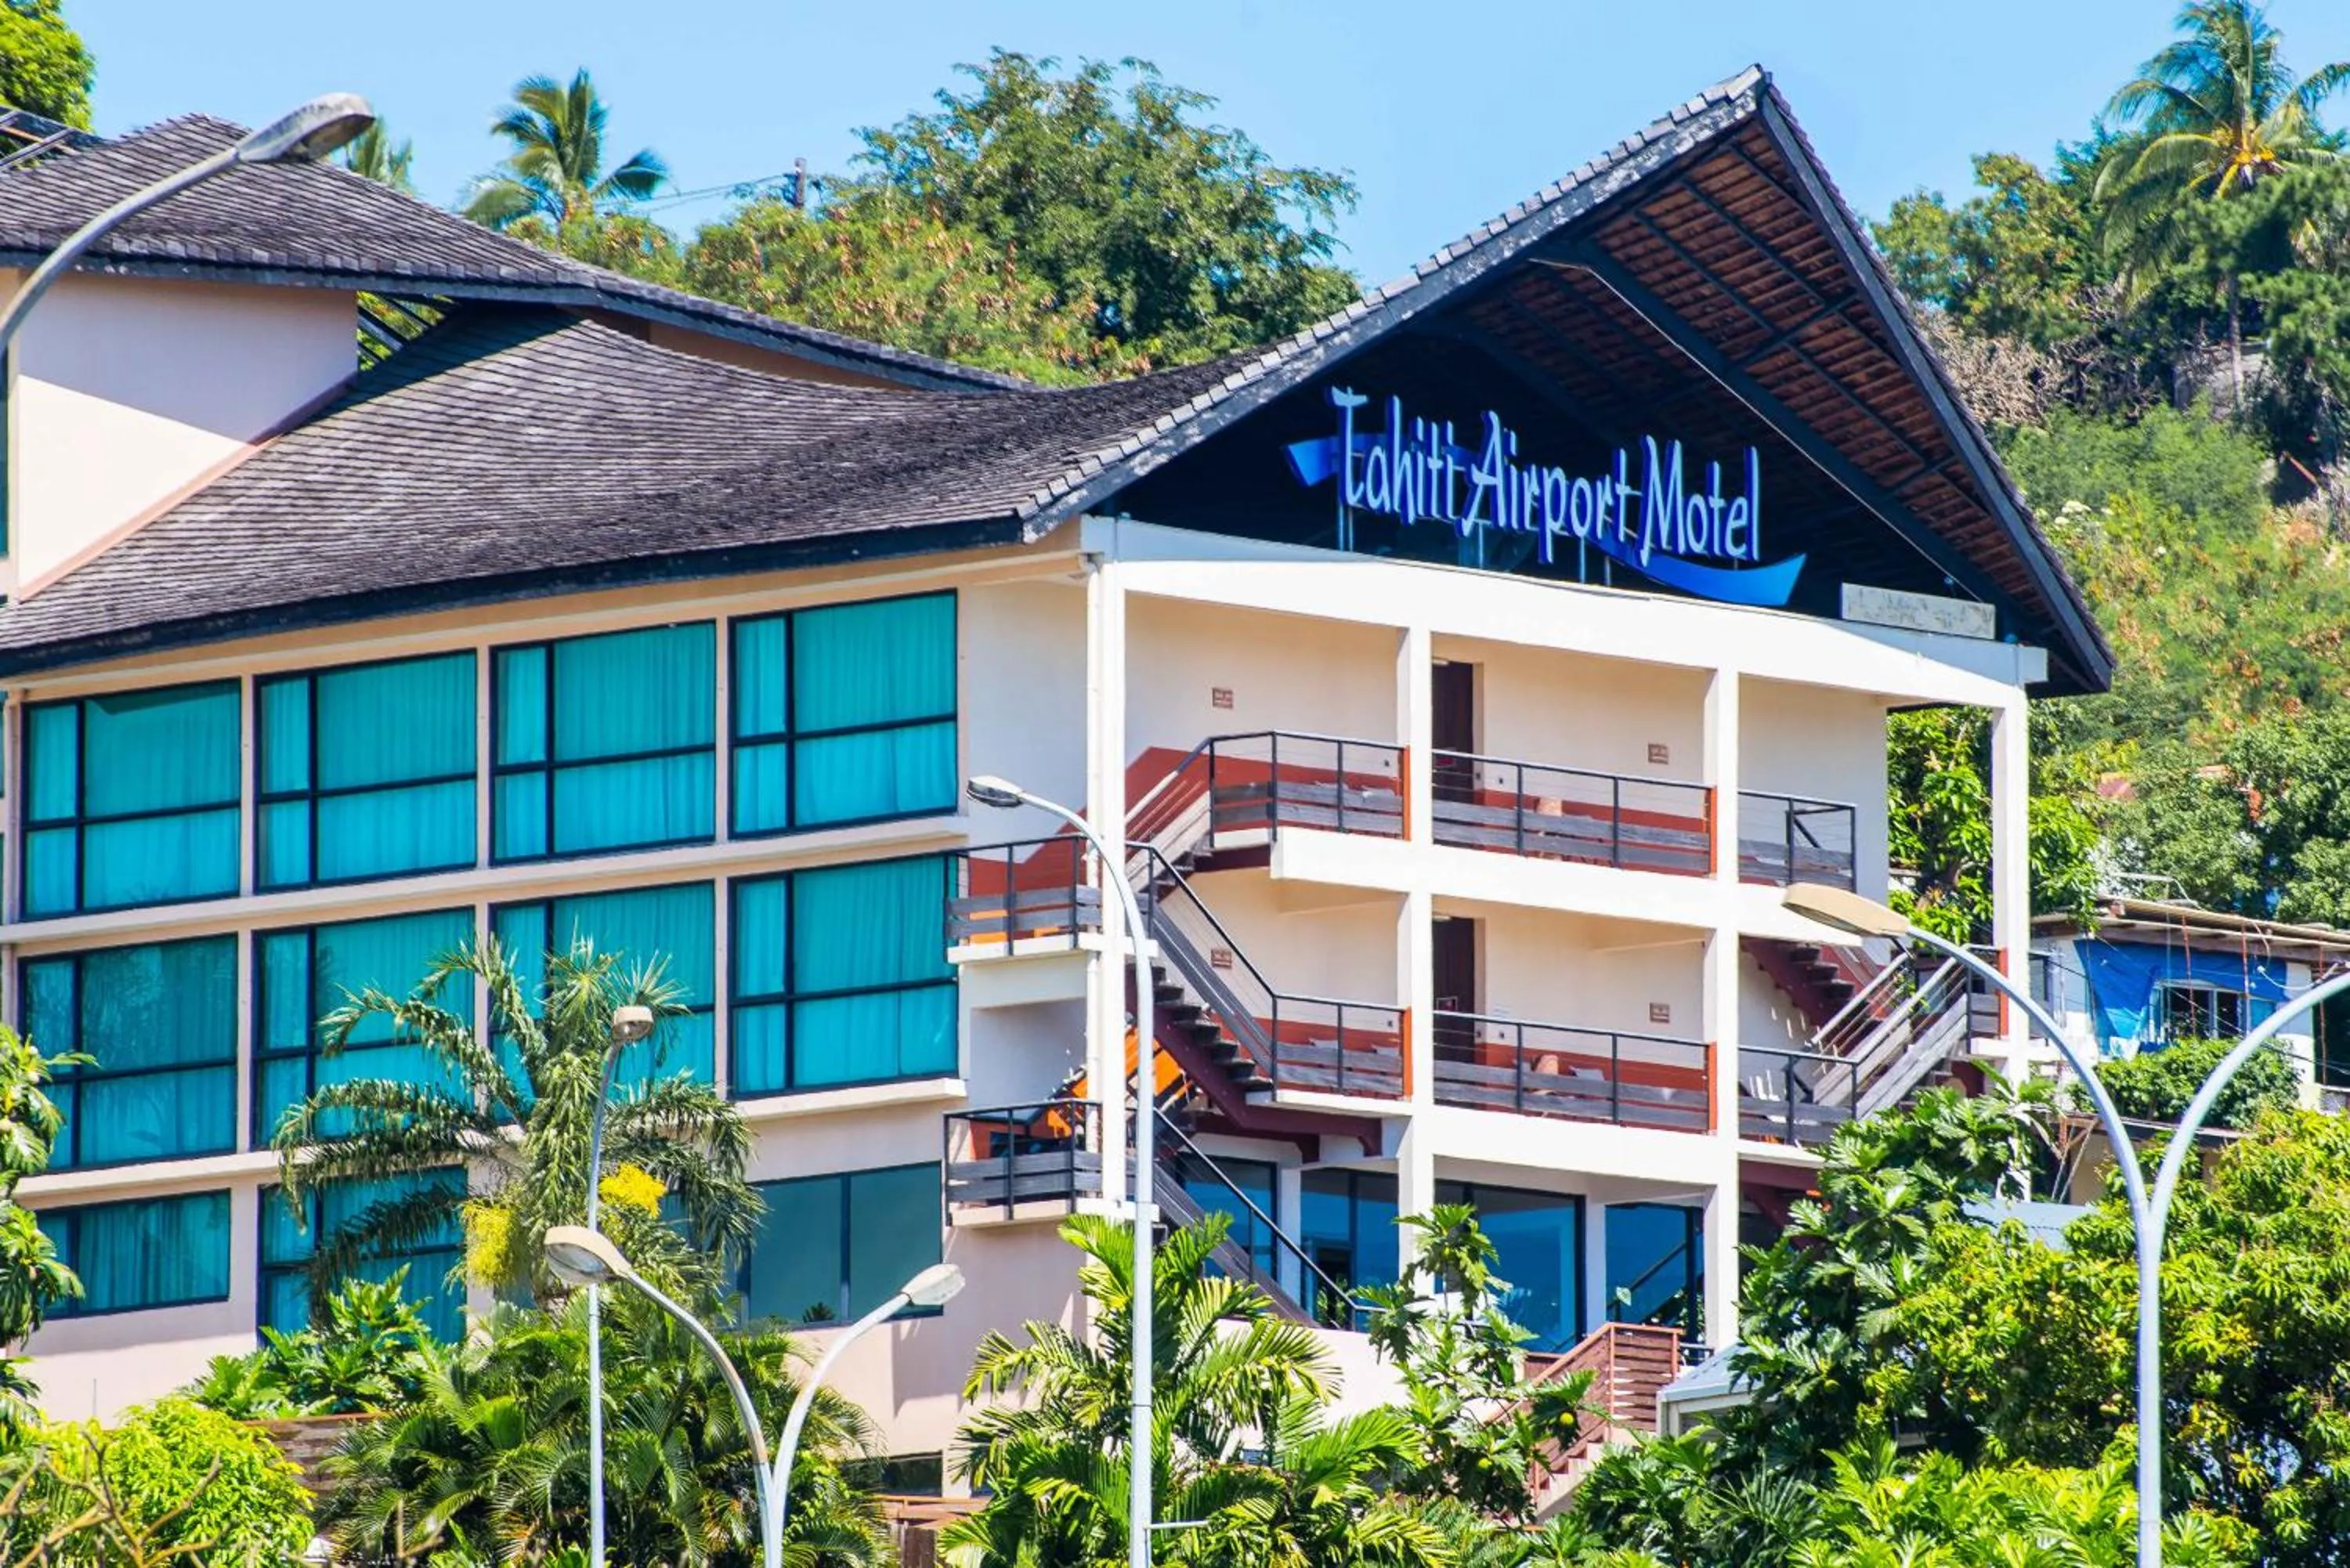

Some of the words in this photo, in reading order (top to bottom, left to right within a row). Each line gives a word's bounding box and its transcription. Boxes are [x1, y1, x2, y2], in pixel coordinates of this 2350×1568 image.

[1331, 386, 1459, 525] Tahiti
[1461, 410, 1641, 563] Airport
[1640, 434, 1759, 566] Motel
